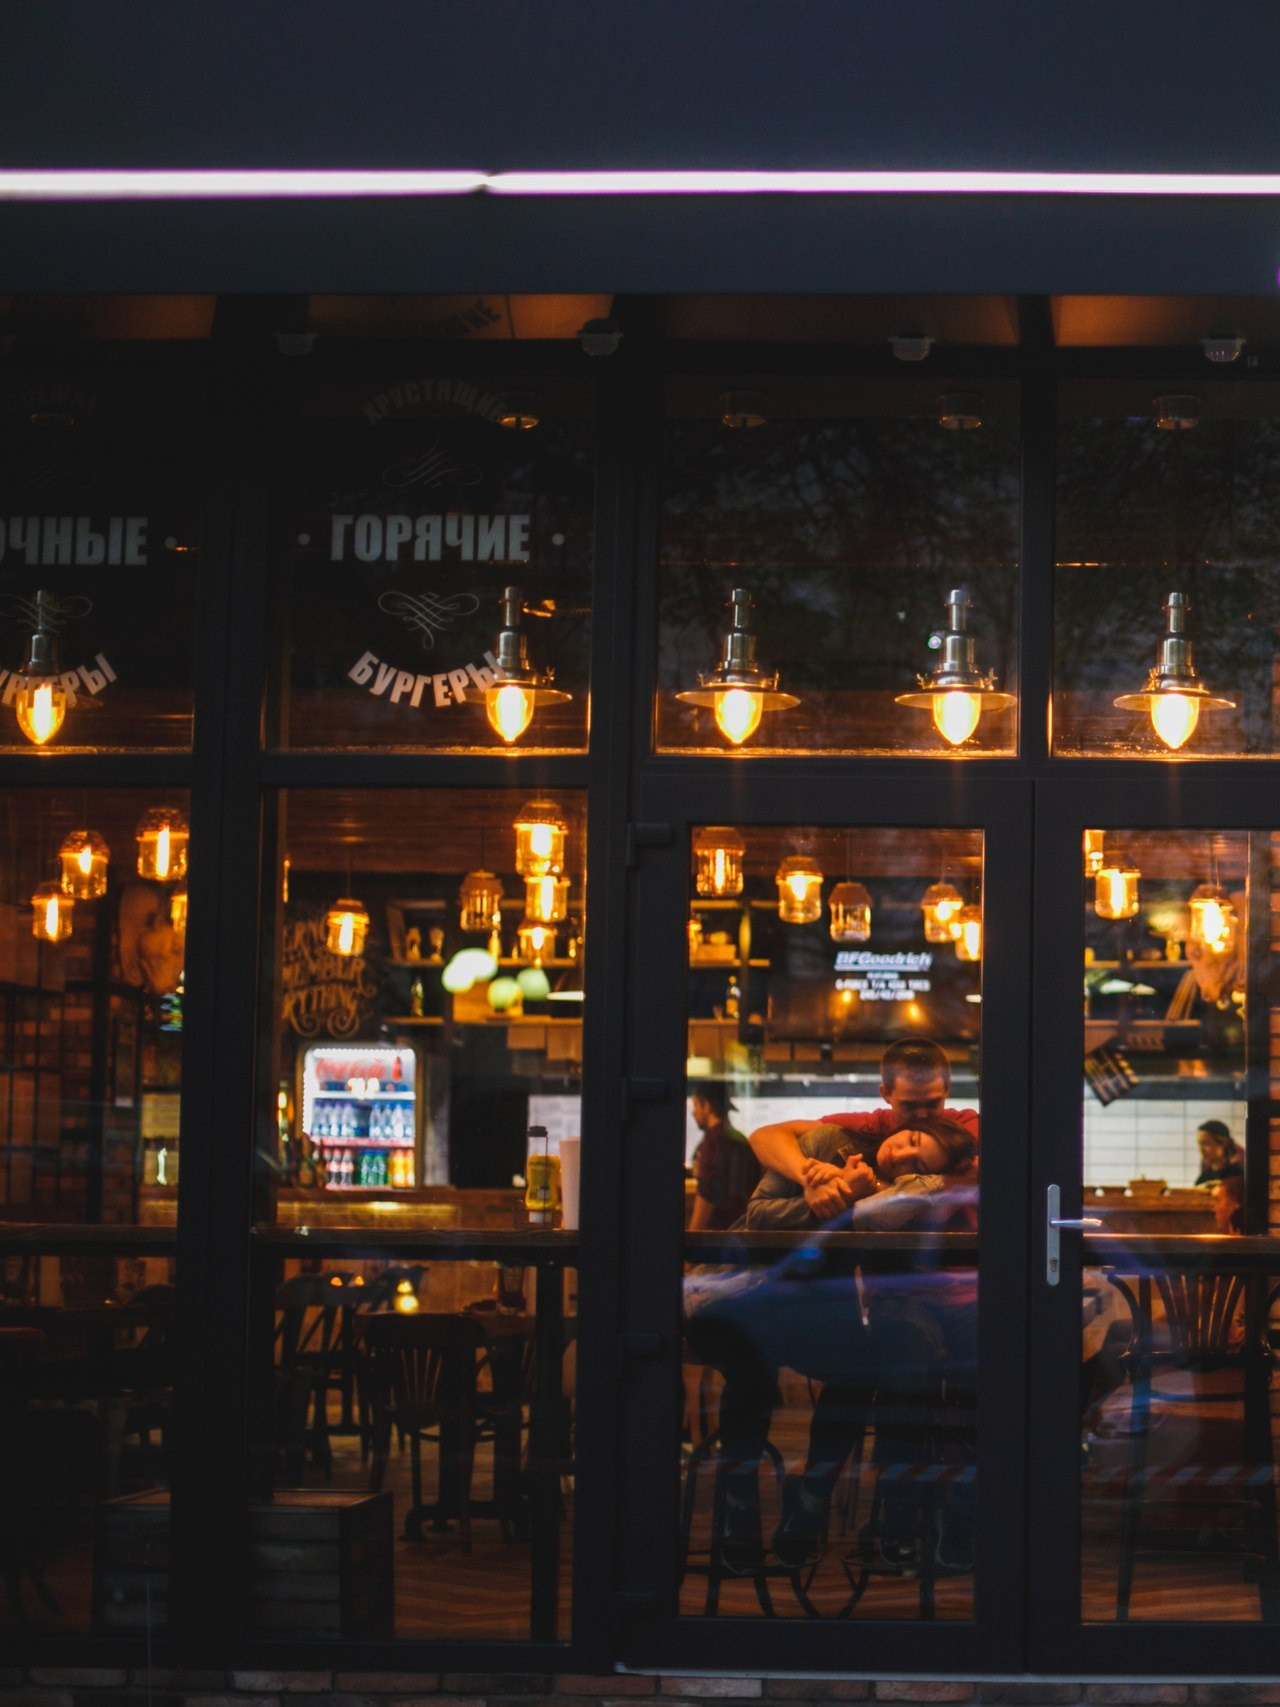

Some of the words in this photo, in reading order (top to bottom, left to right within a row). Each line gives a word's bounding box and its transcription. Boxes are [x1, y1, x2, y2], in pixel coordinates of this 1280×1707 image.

[361, 378, 509, 425] ХРУСТЯЩИЕ
[330, 513, 530, 563] ГОРЯЧИЕ
[347, 649, 507, 709] БУРГЕРЫ
